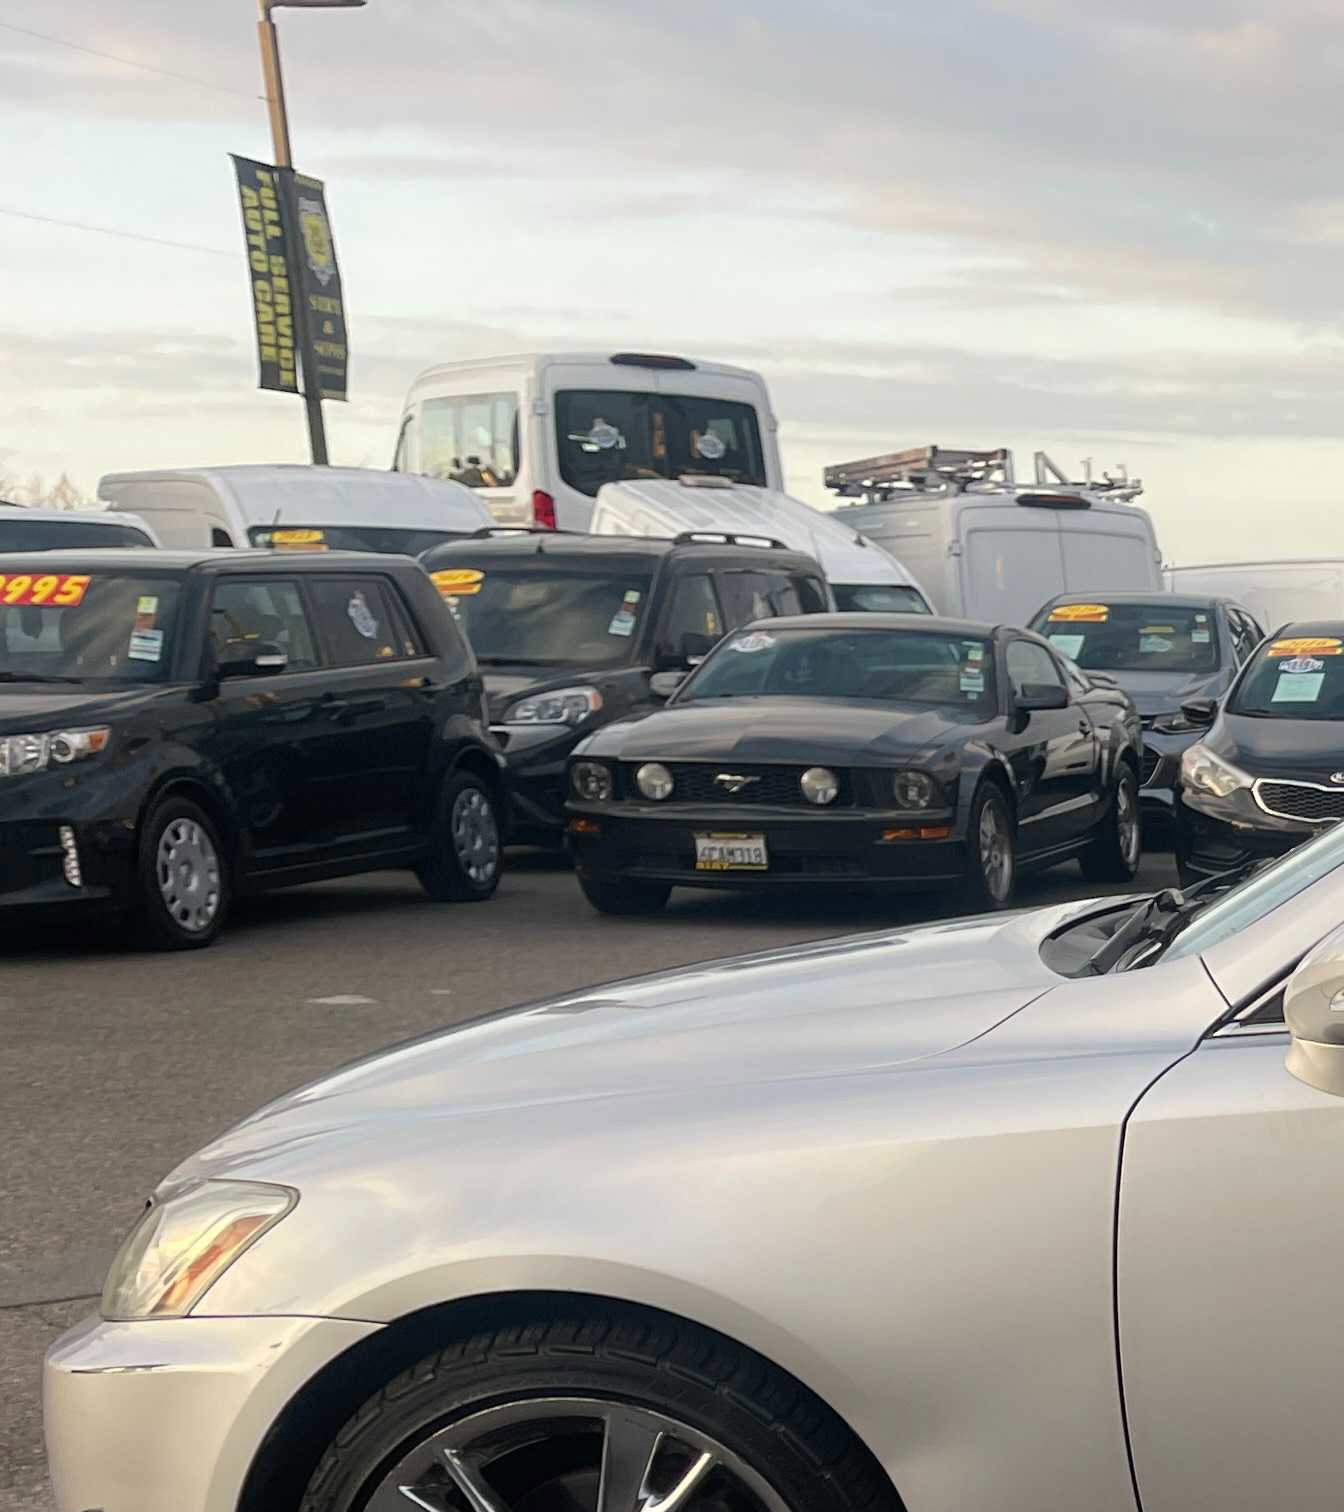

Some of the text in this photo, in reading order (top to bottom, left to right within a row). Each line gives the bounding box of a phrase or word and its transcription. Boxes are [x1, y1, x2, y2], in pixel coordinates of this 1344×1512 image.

[241, 185, 280, 363] AUTO CARE
[255, 170, 296, 385] FULL SERVICE
[0, 575, 88, 604] 995
